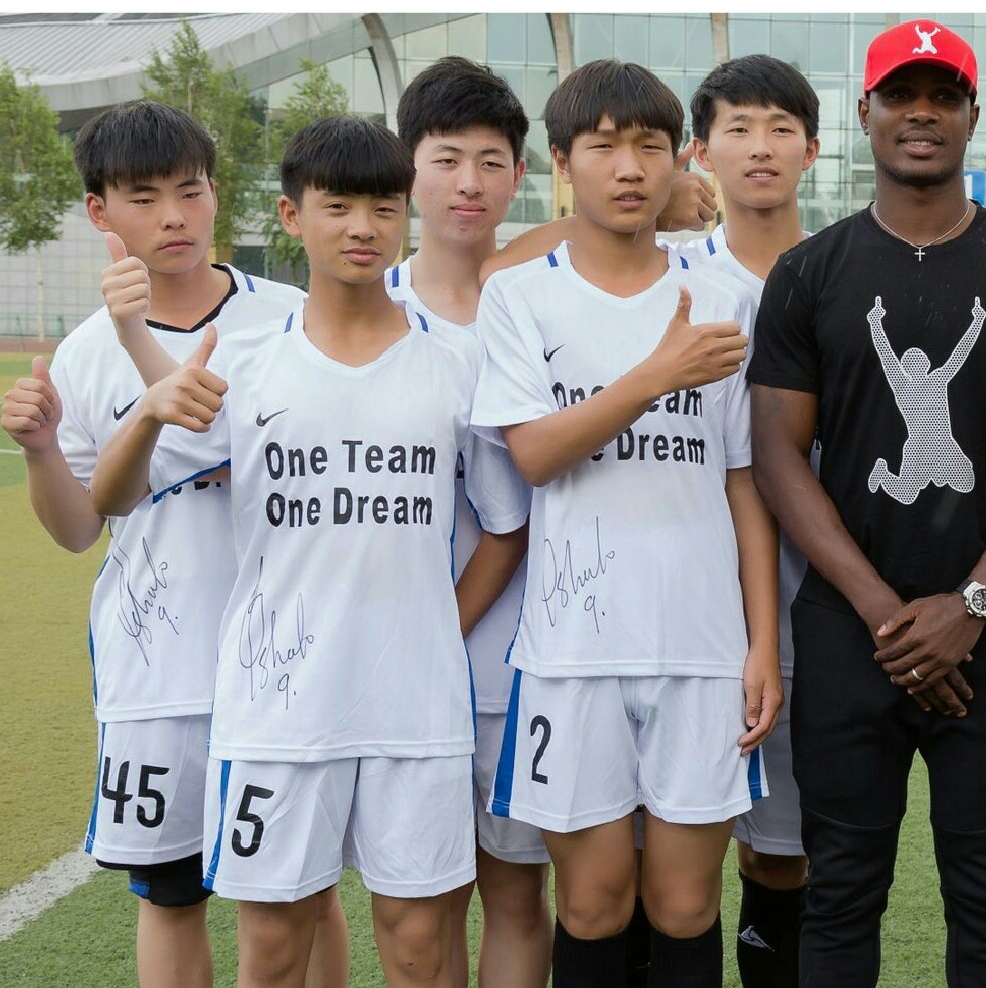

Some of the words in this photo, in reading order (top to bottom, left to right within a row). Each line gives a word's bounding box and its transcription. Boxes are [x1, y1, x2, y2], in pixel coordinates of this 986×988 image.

[265, 441, 328, 480] One
[342, 439, 436, 475] Team
[616, 425, 705, 465] Dream
[265, 492, 320, 527] One
[333, 487, 433, 526] Dream
[530, 715, 552, 785] 2
[101, 756, 169, 828] 45
[231, 785, 274, 858] 5
